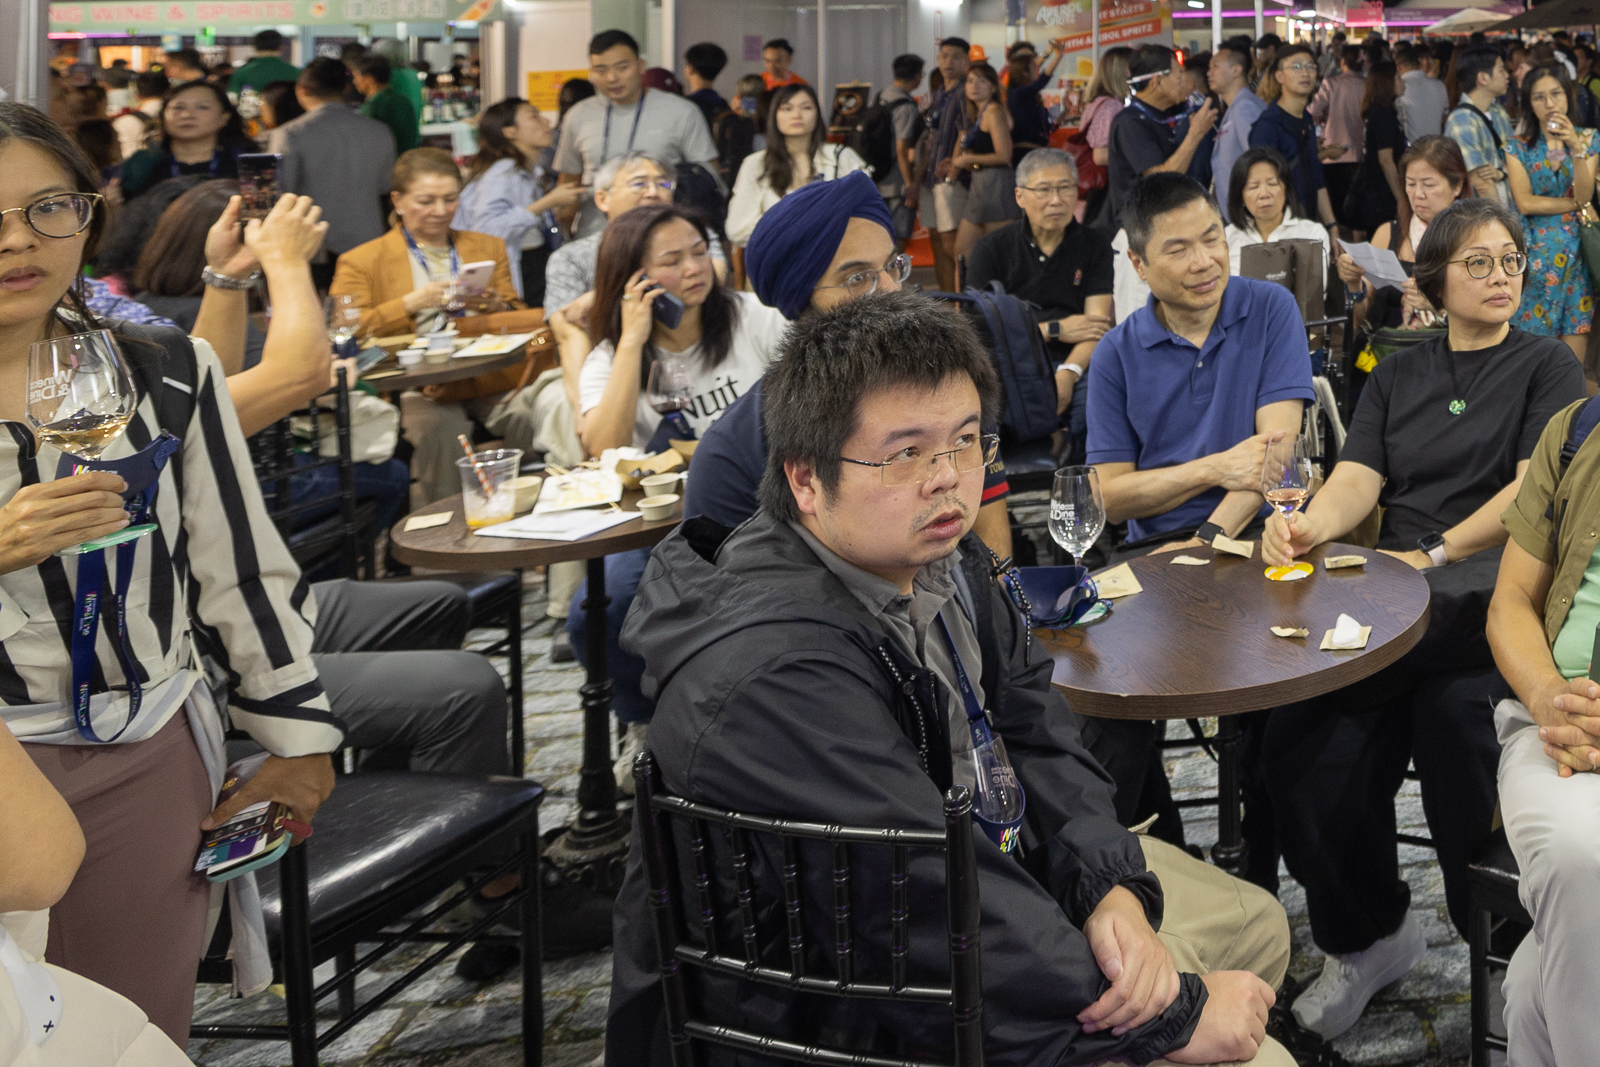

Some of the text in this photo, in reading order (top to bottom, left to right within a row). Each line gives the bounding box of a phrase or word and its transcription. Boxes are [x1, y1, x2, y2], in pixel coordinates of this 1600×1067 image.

[91, 5, 159, 22] WINE
[167, 4, 186, 21] &
[196, 3, 294, 20] SPIRITS
[1121, 23, 1153, 37] SPRITZ
